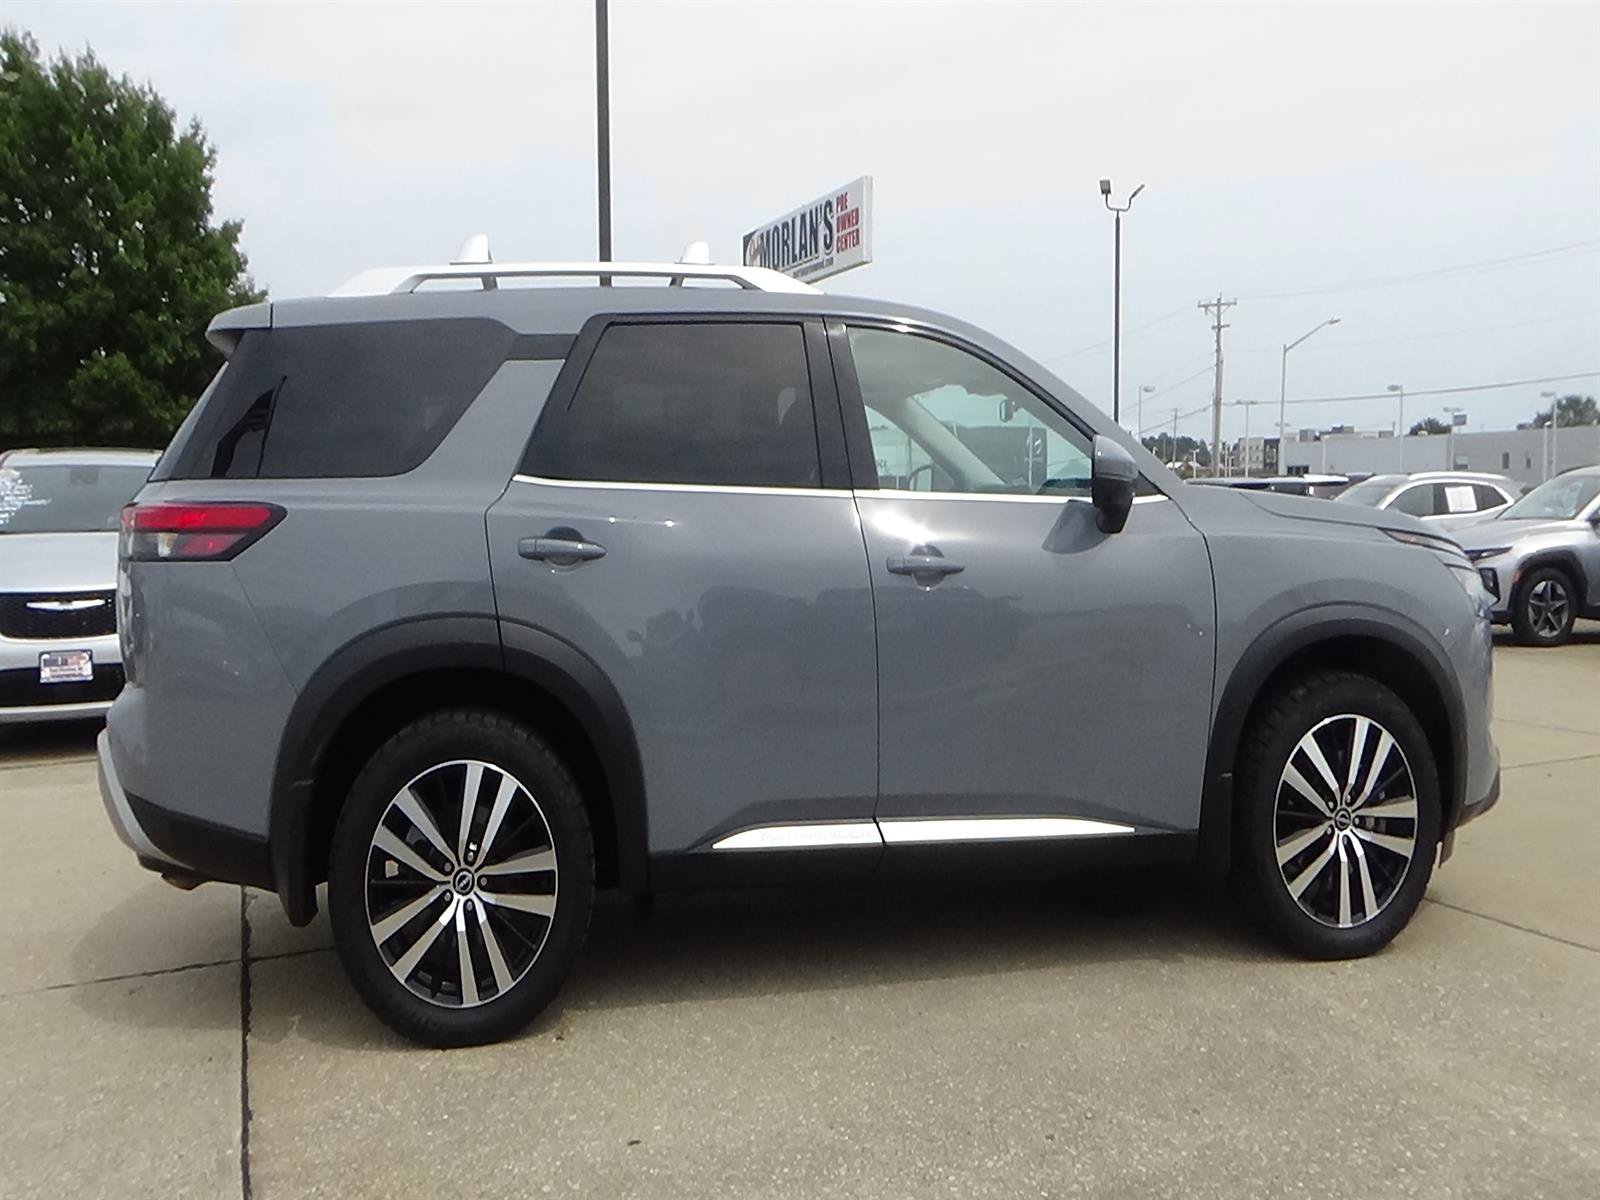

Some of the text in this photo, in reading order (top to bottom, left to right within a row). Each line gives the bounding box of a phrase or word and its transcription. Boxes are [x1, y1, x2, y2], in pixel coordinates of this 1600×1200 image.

[836, 191, 848, 214] PRE
[760, 199, 834, 271] MORLAN'S
[836, 227, 860, 253] CENTER
